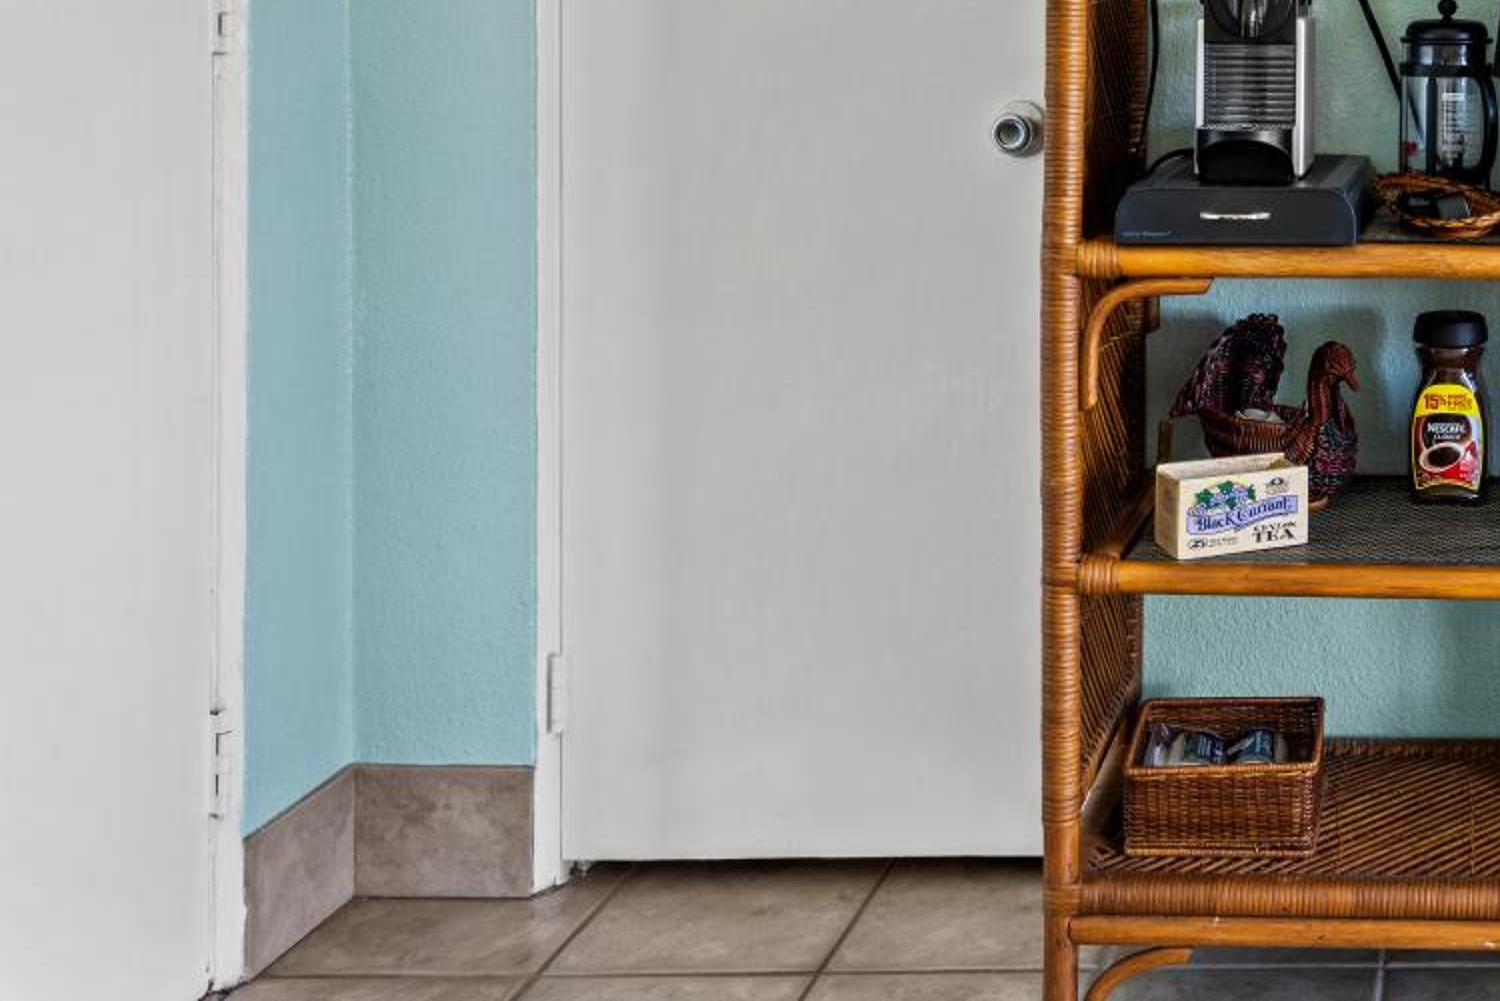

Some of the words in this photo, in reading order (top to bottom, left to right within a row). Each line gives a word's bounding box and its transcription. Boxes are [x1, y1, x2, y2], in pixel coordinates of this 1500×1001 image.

[1196, 513, 1234, 531] Black
[1236, 497, 1289, 523] Currant
[1252, 528, 1296, 544] TEA
